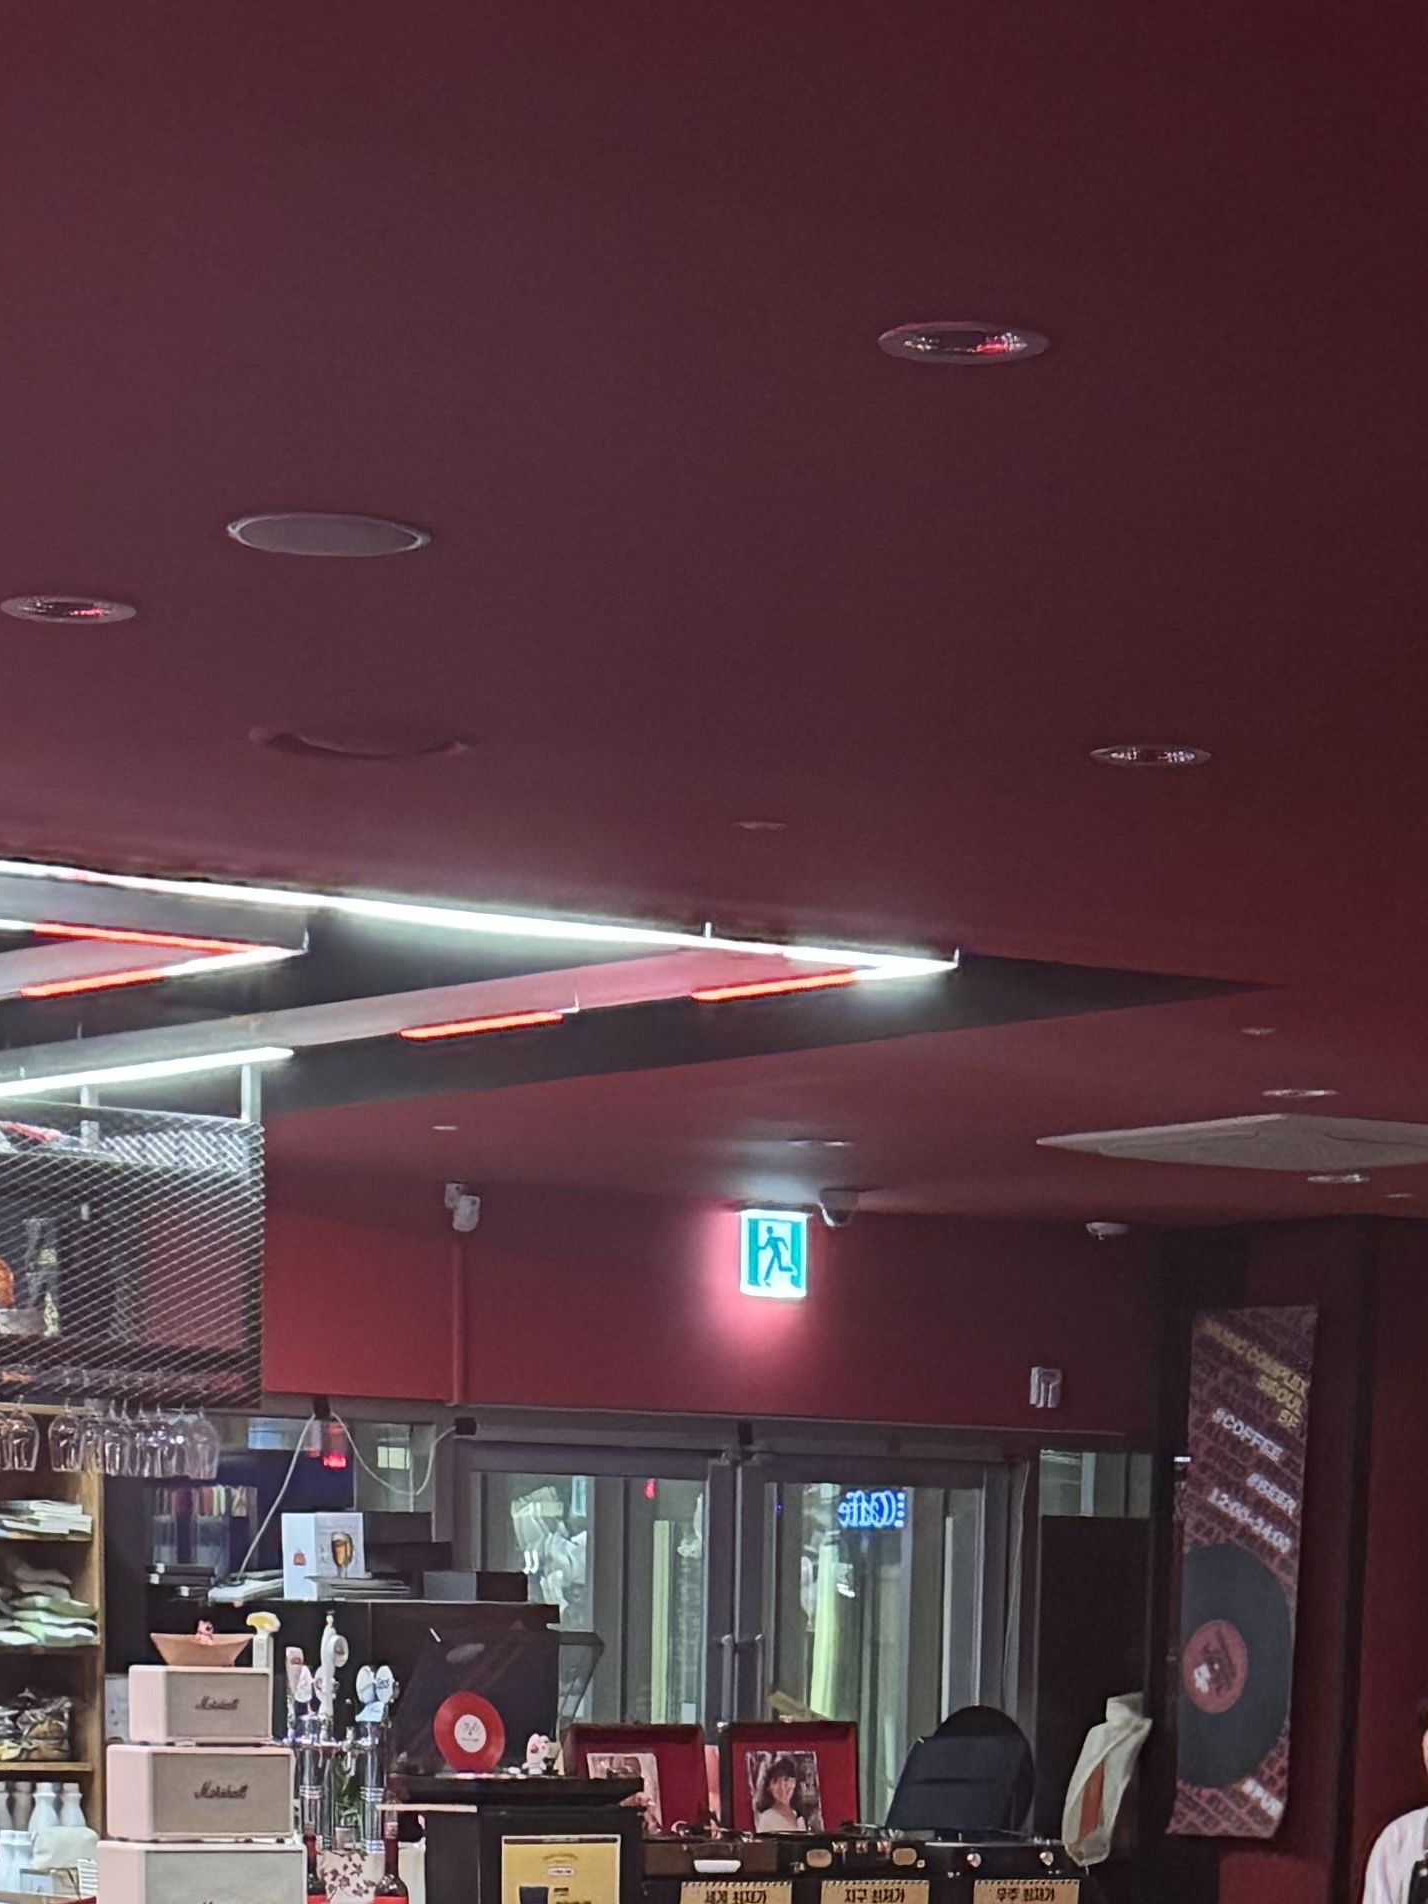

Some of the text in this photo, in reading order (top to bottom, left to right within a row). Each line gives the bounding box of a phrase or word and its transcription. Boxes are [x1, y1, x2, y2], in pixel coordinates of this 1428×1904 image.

[1256, 1374, 1303, 1415] SEOUL
[195, 1696, 240, 1711] Marshall
[194, 1781, 249, 1800] Marshall
